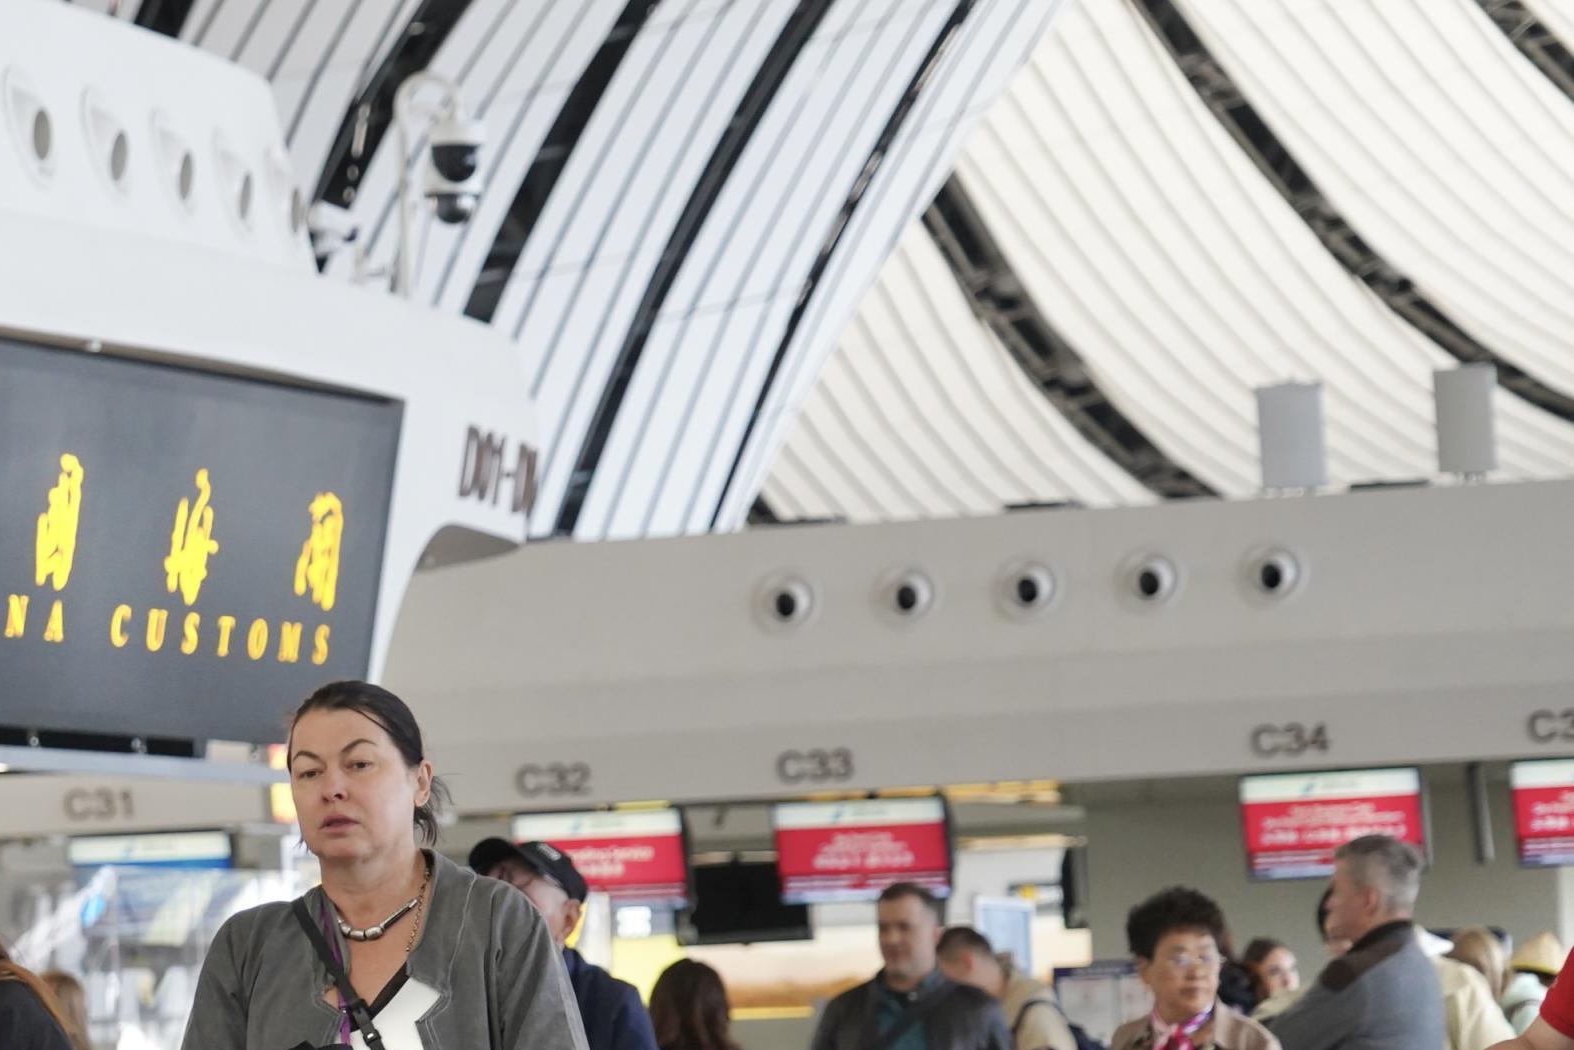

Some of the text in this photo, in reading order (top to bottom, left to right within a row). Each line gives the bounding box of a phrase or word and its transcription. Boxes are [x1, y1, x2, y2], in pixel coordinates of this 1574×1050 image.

[110, 604, 332, 666] CUSTOMS
[1248, 722, 1331, 757] C34
[1526, 708, 1574, 744] C3
[516, 761, 592, 798] C32
[775, 747, 855, 784] C33
[63, 787, 134, 822] C31
